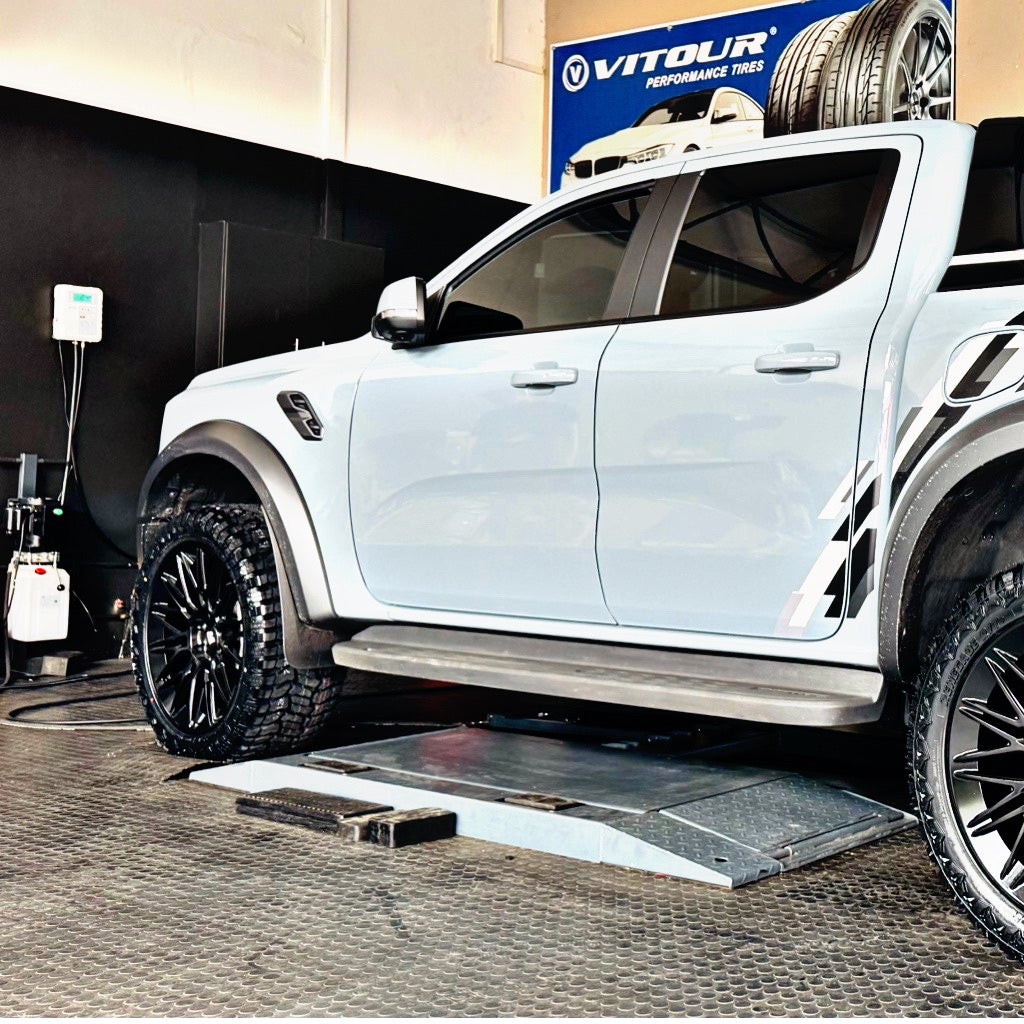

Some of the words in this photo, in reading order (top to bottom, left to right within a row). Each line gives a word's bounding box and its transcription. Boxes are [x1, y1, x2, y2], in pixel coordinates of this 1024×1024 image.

[593, 31, 768, 80] VITOUR
[645, 65, 729, 89] PERFORMANCE
[731, 59, 765, 76] TIRES
